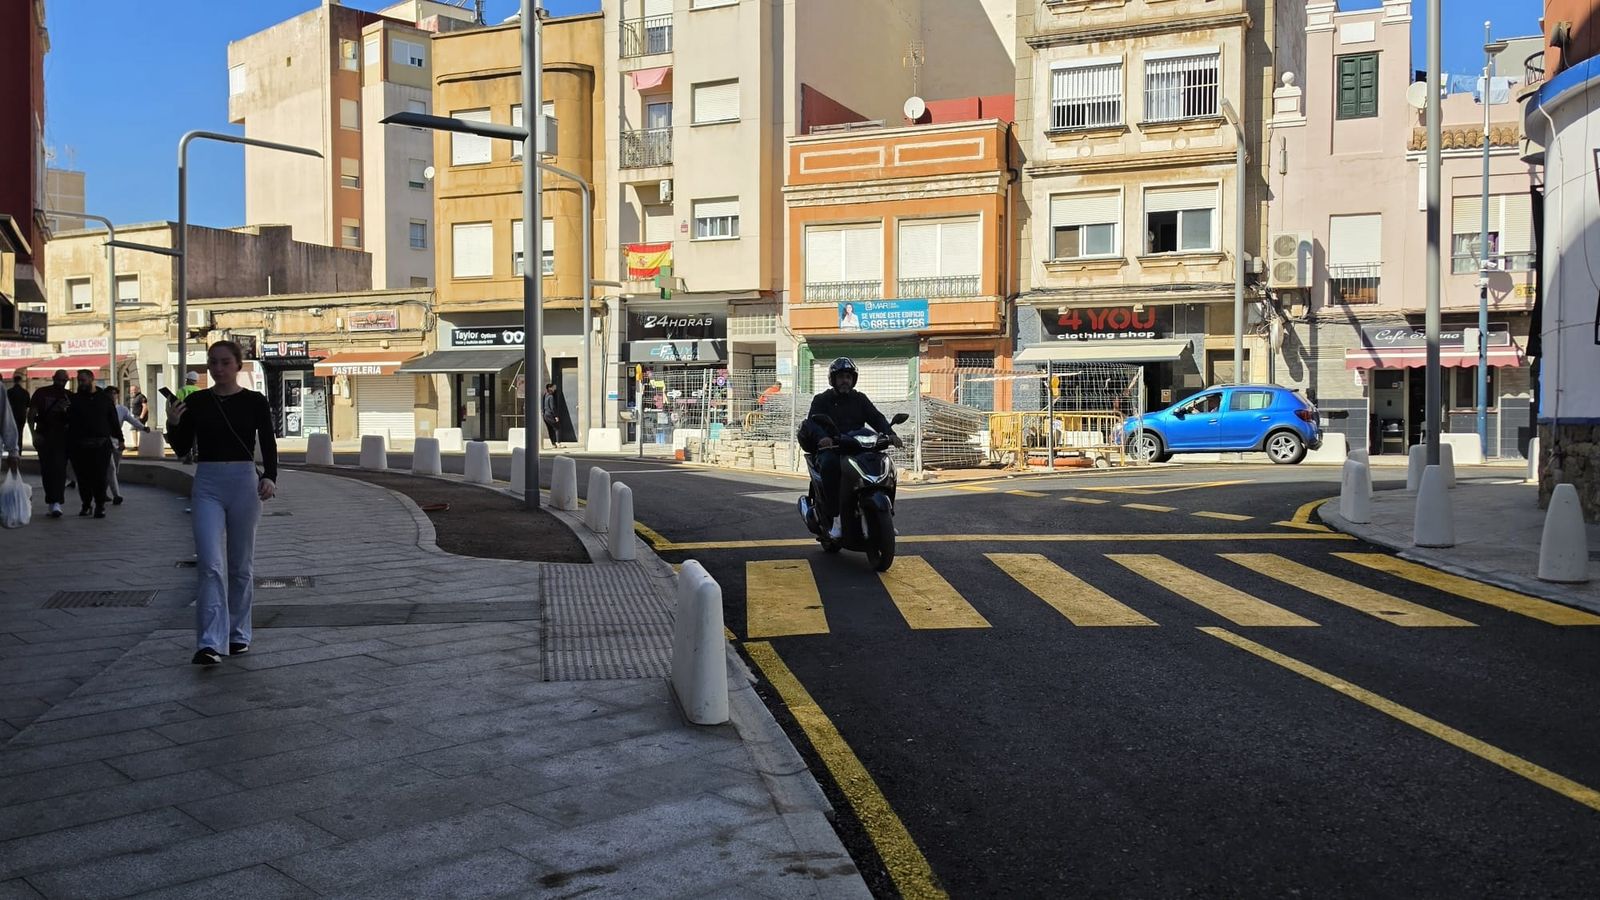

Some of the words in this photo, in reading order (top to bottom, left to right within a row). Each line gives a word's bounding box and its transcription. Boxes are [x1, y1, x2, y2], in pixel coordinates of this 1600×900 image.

[644, 315, 668, 329] 24
[668, 317, 713, 327] HORAS
[889, 319, 906, 328] 511
[1058, 309, 1082, 330] 4
[1087, 307, 1156, 330] YOU
[455, 330, 479, 341] Taylor
[1057, 331, 1115, 340] clothing
[1119, 331, 1156, 339] shop
